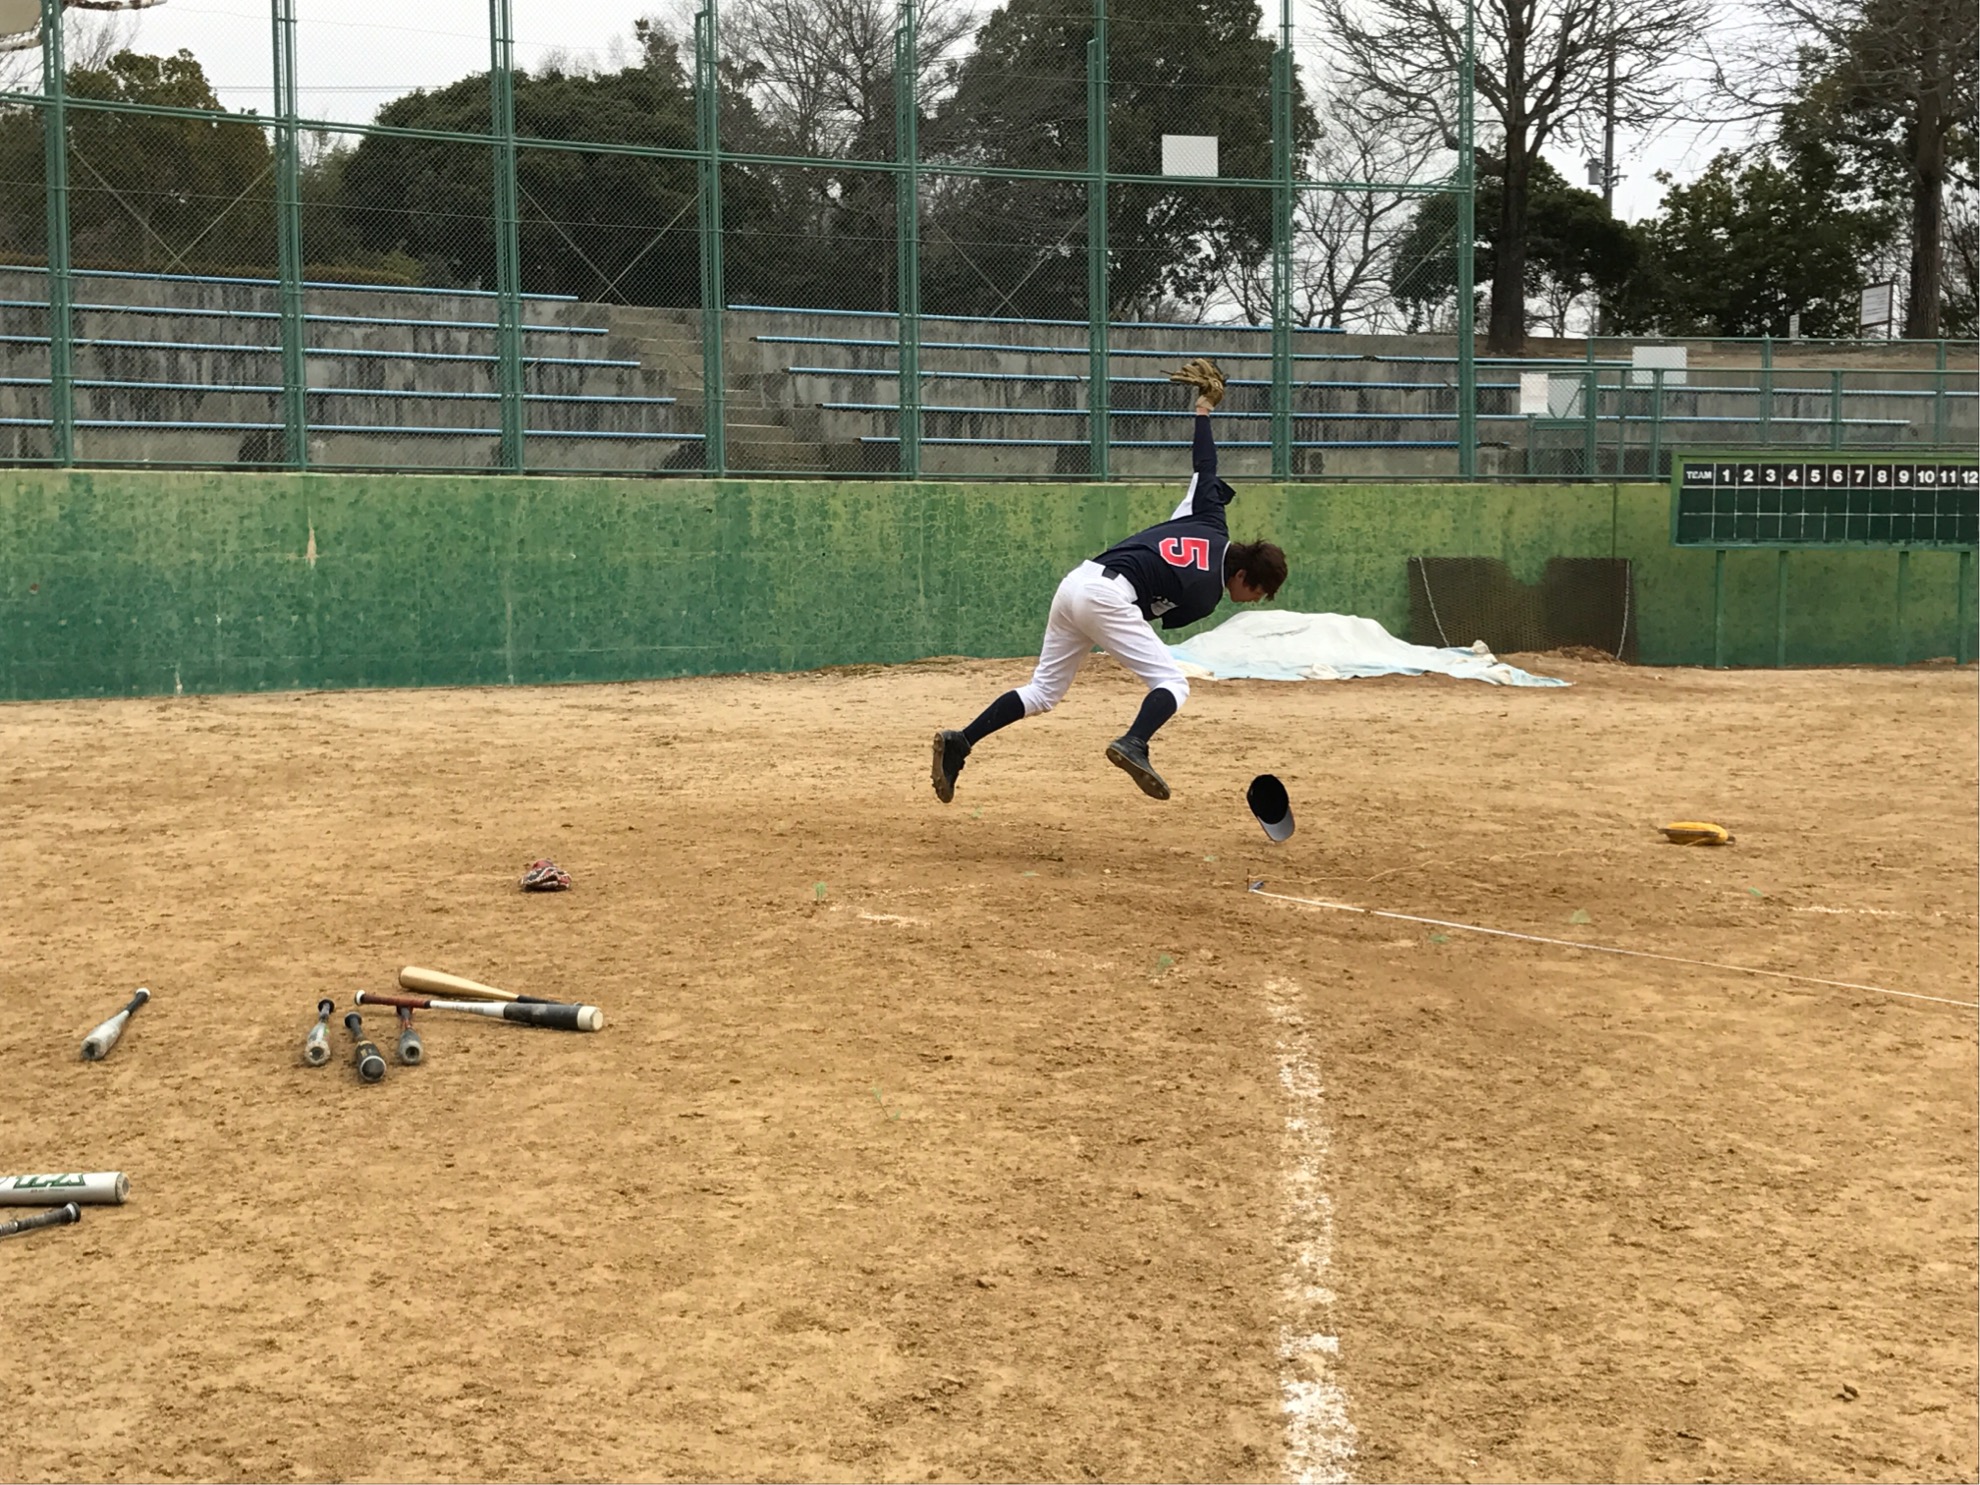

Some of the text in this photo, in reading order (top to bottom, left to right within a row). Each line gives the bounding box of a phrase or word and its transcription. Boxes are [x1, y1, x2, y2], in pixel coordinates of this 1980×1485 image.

[1686, 469, 1979, 484] TEAM 1 2 3 4 5 6 7 8 9 10 11 12
[1158, 536, 1210, 572] 5
